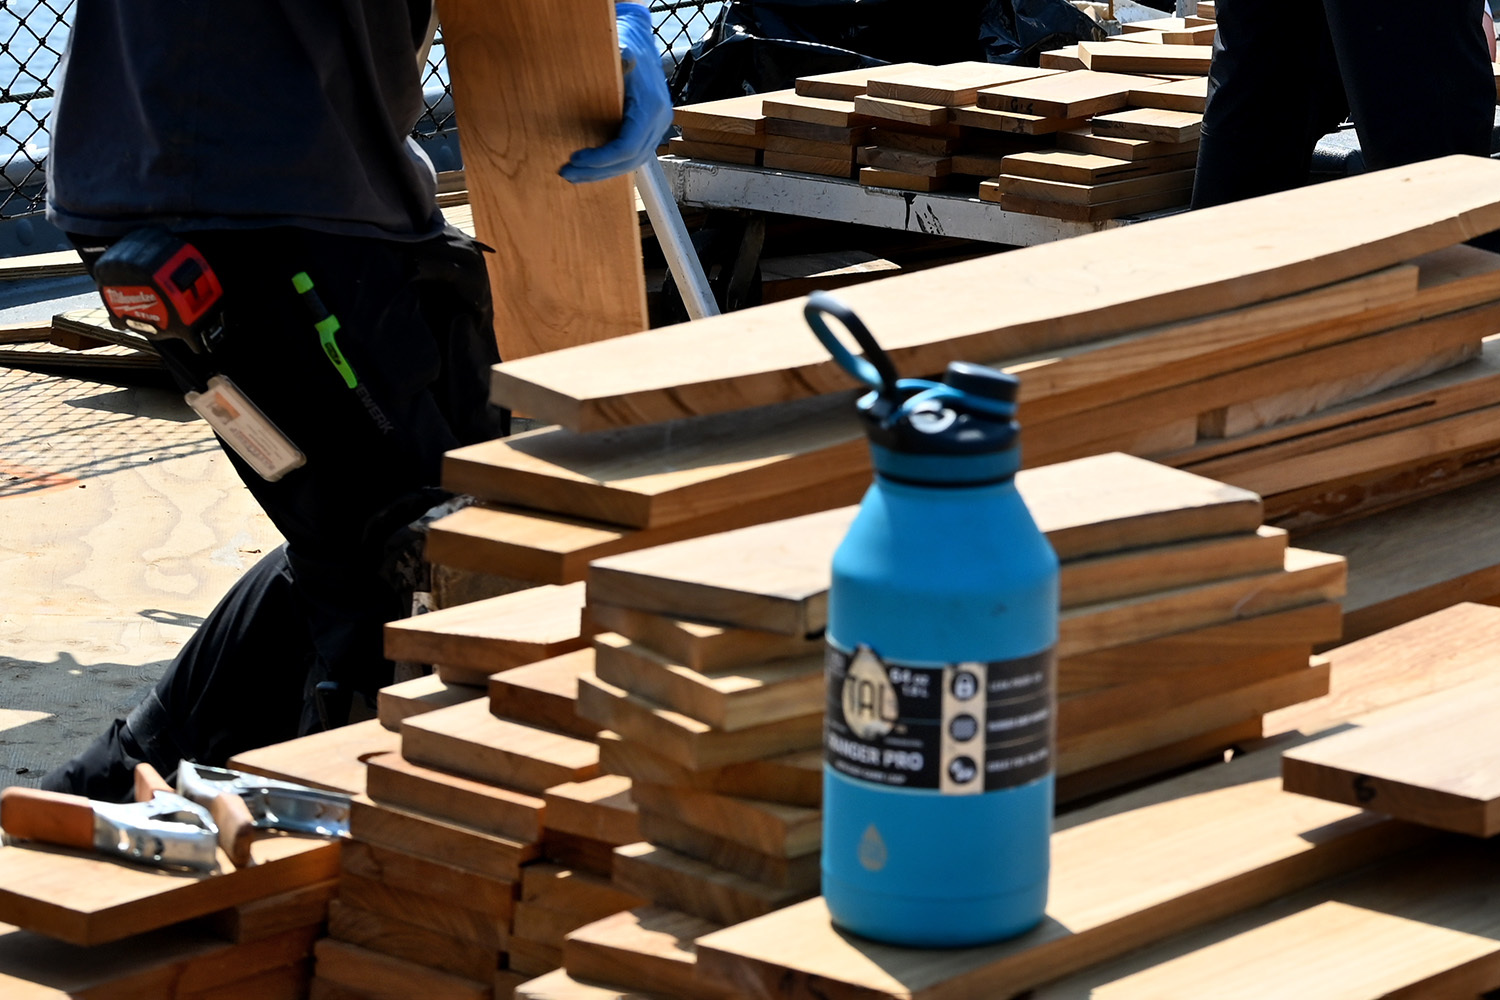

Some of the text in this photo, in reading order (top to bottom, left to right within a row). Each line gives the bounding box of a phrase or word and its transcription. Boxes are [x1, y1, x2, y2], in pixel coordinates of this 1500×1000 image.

[134, 310, 161, 321] STUD
[847, 674, 899, 723] TAL
[882, 749, 925, 772] PRO
